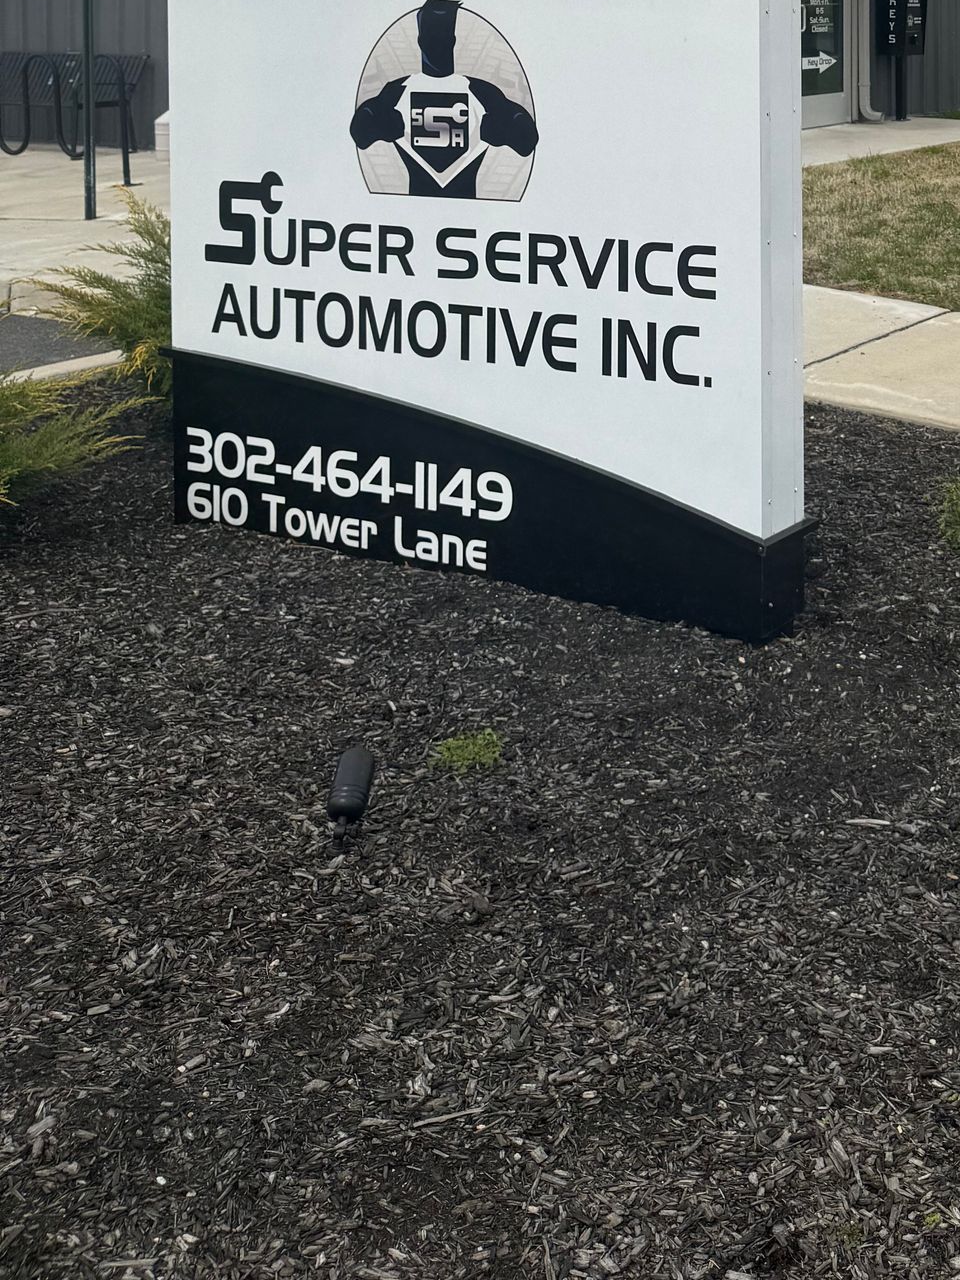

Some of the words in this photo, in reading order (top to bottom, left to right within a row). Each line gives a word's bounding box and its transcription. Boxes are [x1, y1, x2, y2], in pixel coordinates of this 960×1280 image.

[807, 58, 818, 67] Key
[204, 171, 415, 277] SUPER
[437, 228, 717, 300] SERVICE
[211, 282, 578, 373] AUTOMOTIVE
[601, 317, 713, 388] INC.
[186, 426, 513, 522] 302-464-1149
[186, 482, 249, 527] 610
[394, 515, 488, 571] Lane
